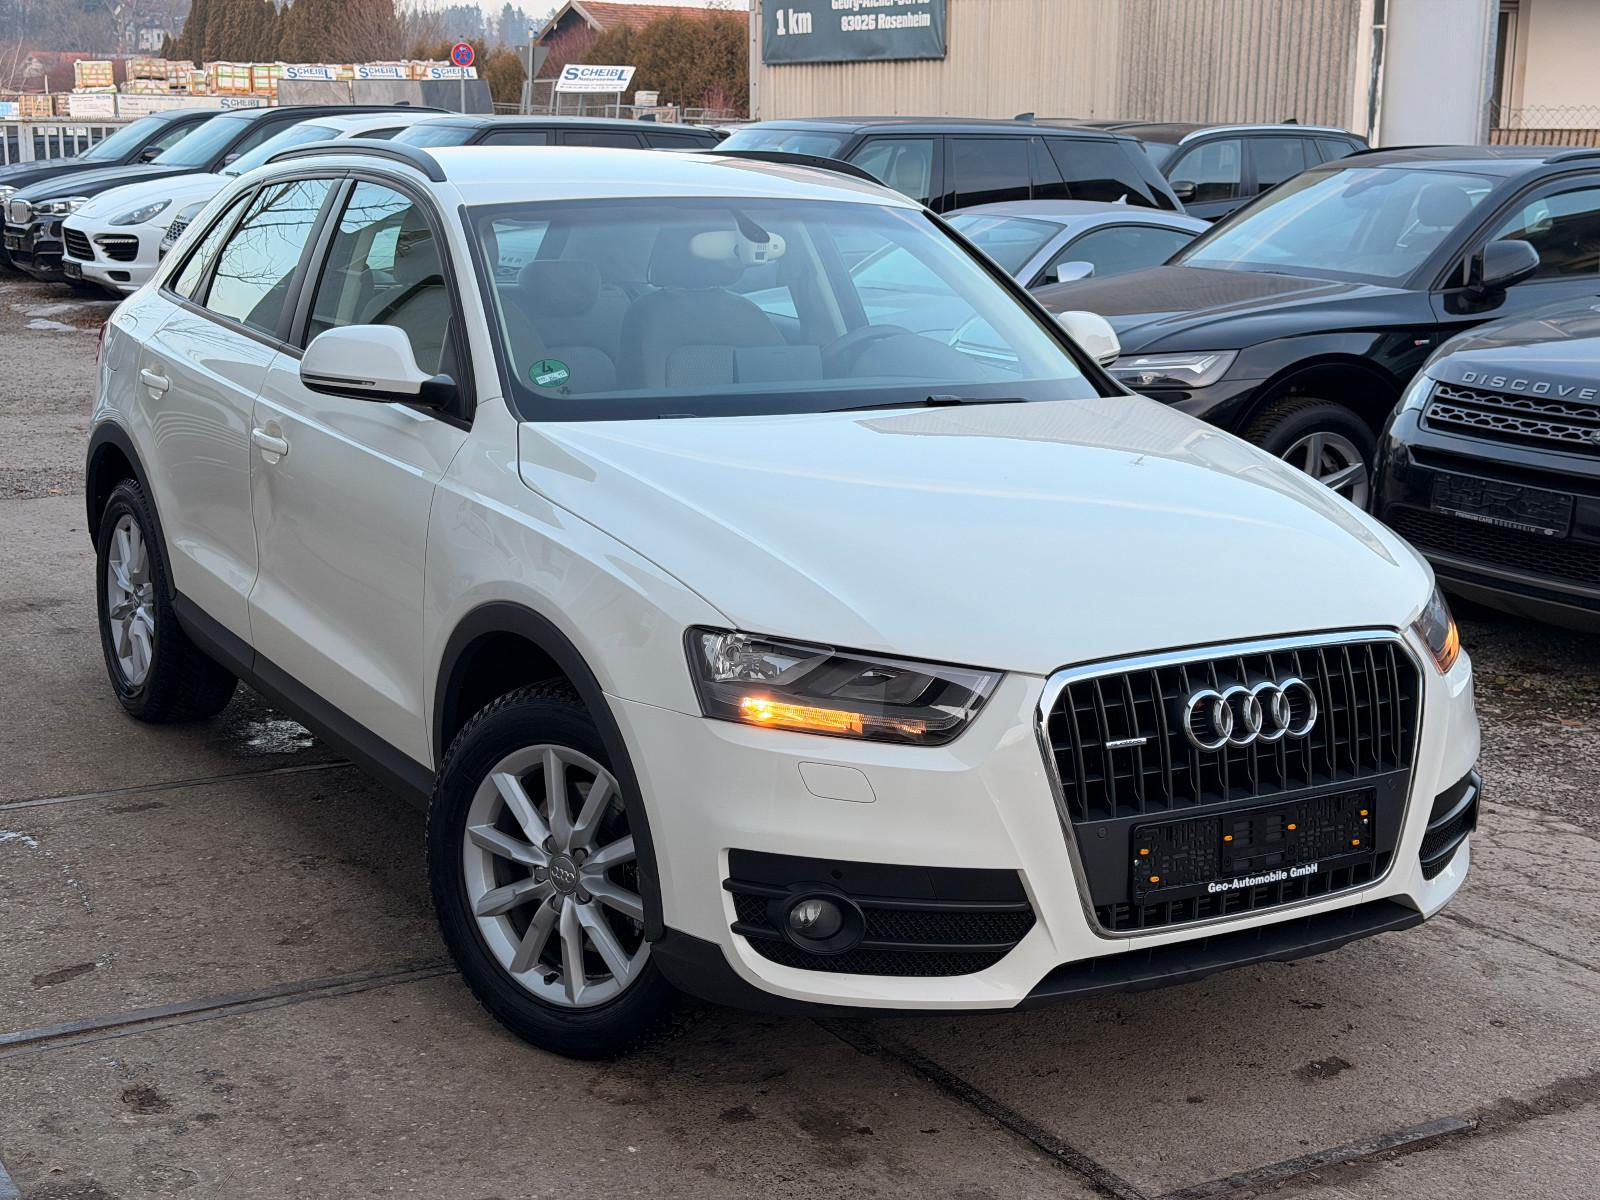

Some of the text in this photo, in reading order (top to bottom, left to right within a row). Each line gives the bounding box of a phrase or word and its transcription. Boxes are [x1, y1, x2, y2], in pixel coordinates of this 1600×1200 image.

[776, 8, 813, 36] 1 km
[841, 11, 931, 32] 83026 Rosenheim
[287, 67, 332, 79] SCHEIBL
[359, 67, 402, 79] SCHEIBL
[431, 68, 474, 79] SCHEIL
[564, 67, 627, 81] SCHEIBL
[1461, 370, 1598, 400] DISCOVE
[1207, 863, 1318, 893] Geo-Automobile GmbH
